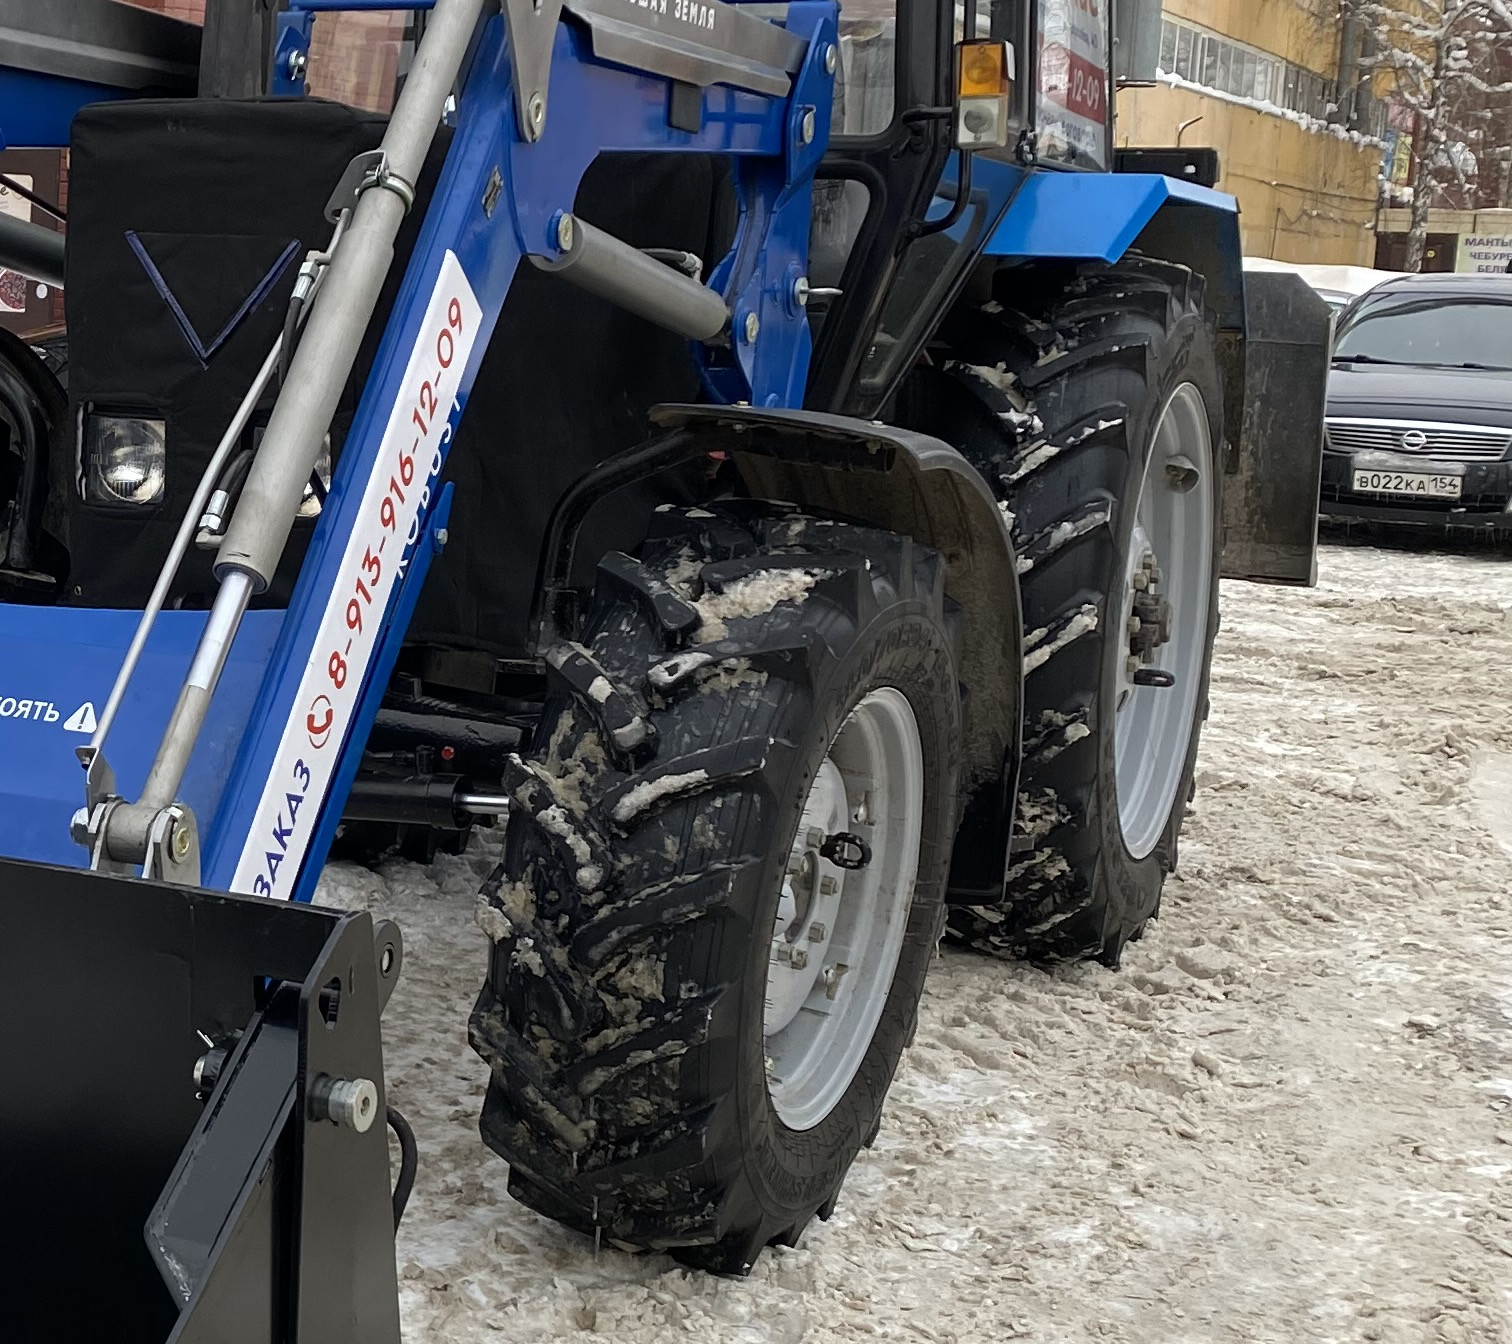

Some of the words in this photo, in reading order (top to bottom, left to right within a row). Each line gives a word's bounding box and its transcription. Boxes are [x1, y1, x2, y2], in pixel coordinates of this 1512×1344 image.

[253, 758, 311, 898] ЗАКАЗ
[328, 297, 463, 689] 8-913-916-12-09
[1430, 477, 1459, 490] 154
